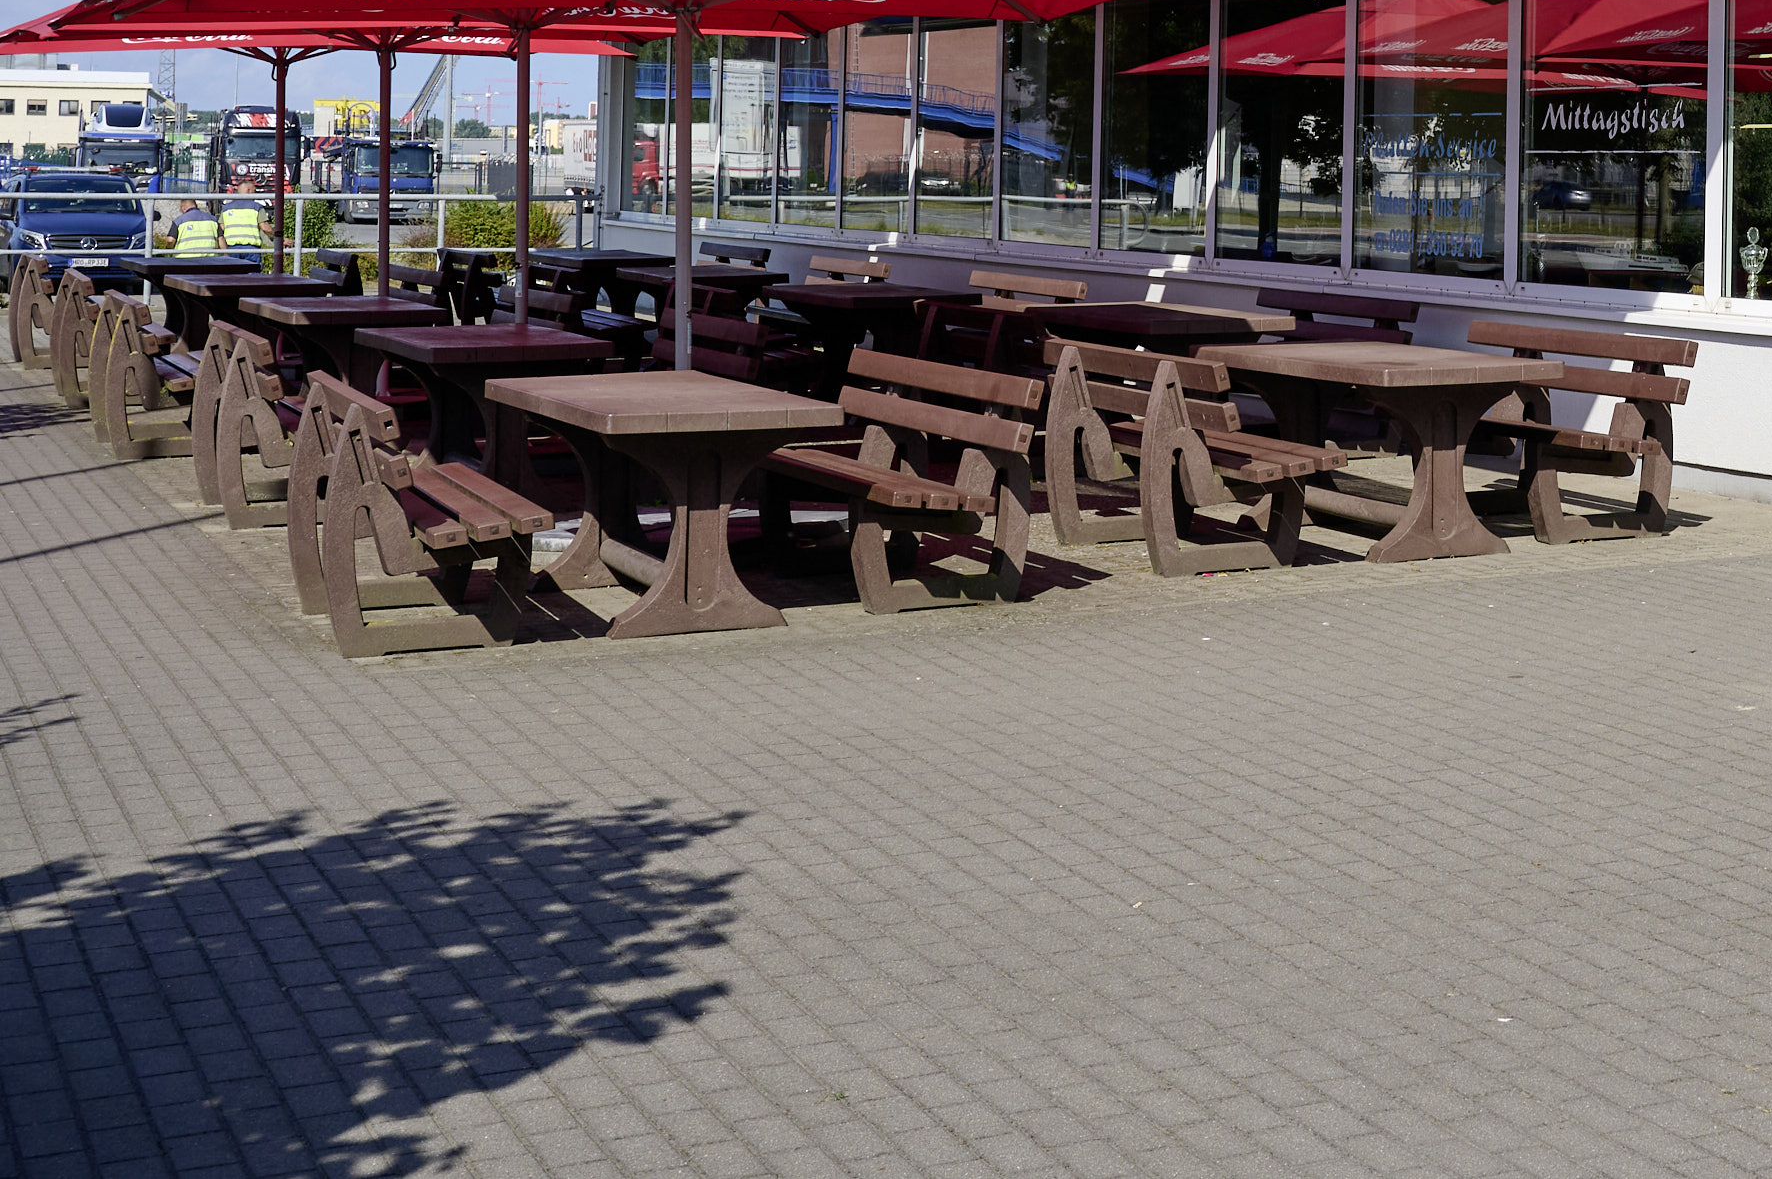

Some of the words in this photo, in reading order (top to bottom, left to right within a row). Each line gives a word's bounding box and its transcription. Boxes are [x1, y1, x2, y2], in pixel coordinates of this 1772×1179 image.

[1541, 98, 1685, 139] Mittagstisch
[1410, 191, 1428, 216] Sie
[1433, 198, 1453, 218] uns
[1458, 197, 1473, 219] an
[1427, 232, 1447, 257] 350
[1450, 233, 1465, 258] 52
[1469, 234, 1484, 259] 70
